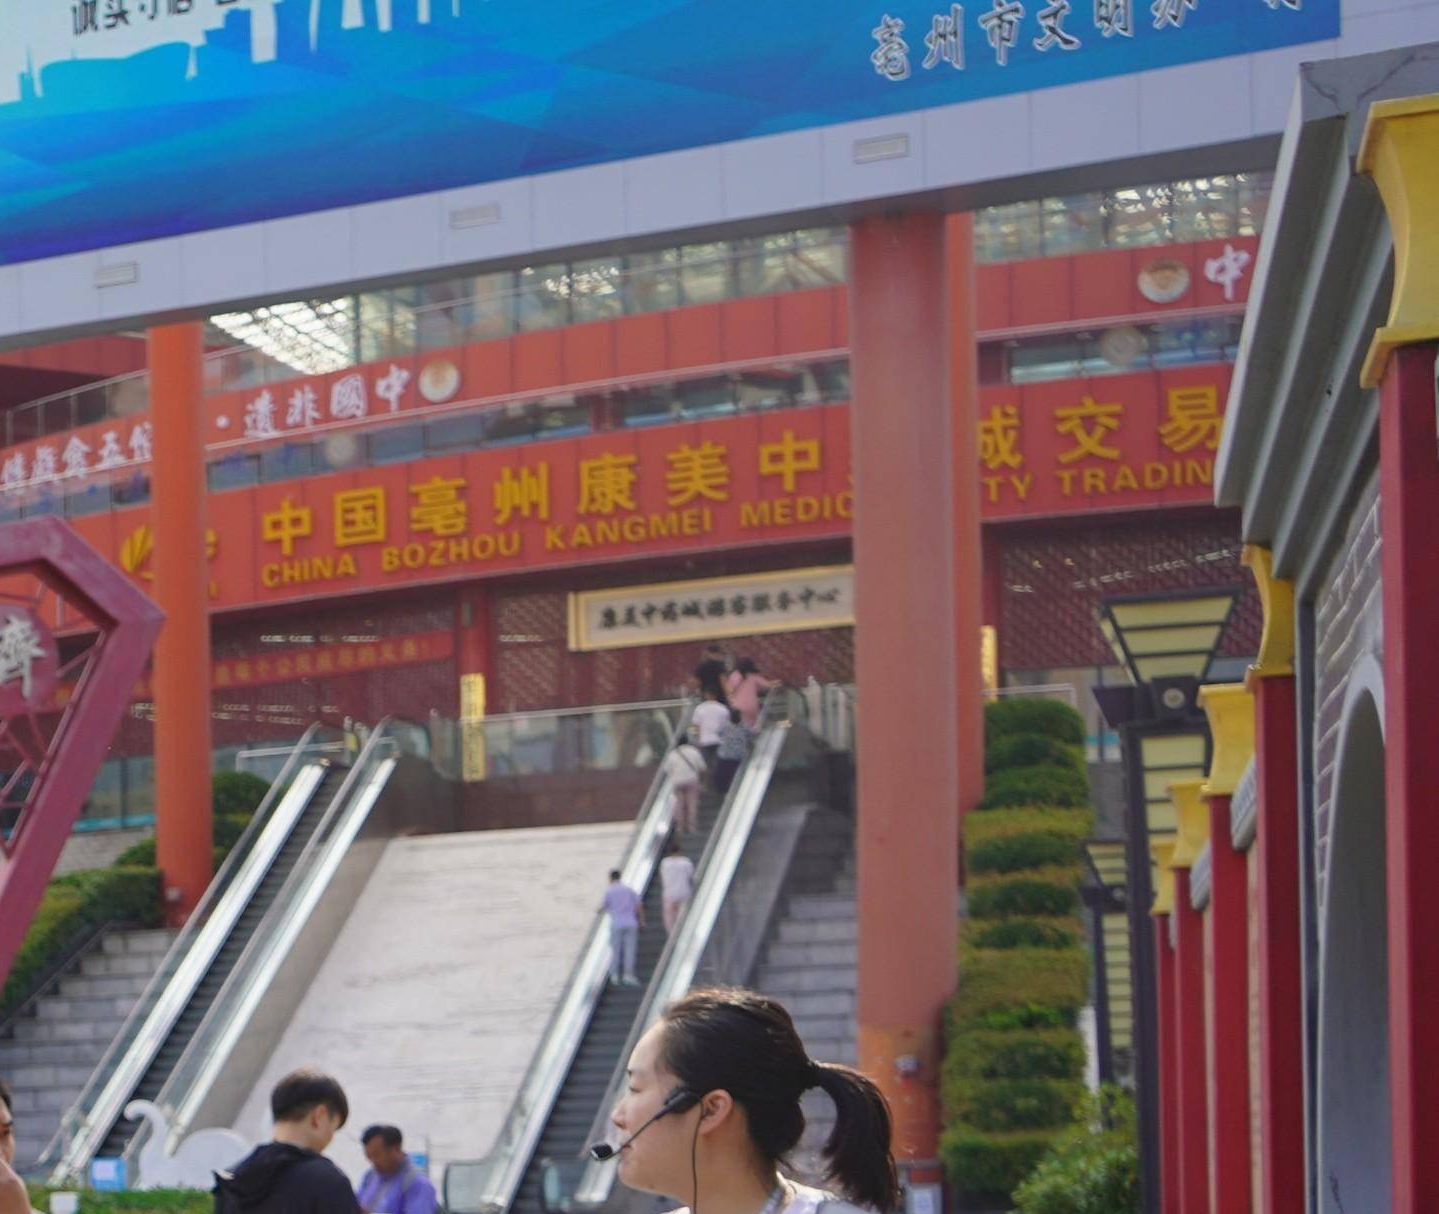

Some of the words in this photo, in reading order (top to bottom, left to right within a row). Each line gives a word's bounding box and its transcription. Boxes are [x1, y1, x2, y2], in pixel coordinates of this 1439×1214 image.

[262, 553, 358, 587] CHINA
[380, 530, 521, 573] BOZHOU
[544, 507, 713, 550] KANGMEI
[739, 491, 853, 528] MEDIC
[982, 473, 1033, 503] TY
[1055, 458, 1214, 494] TRADIN
